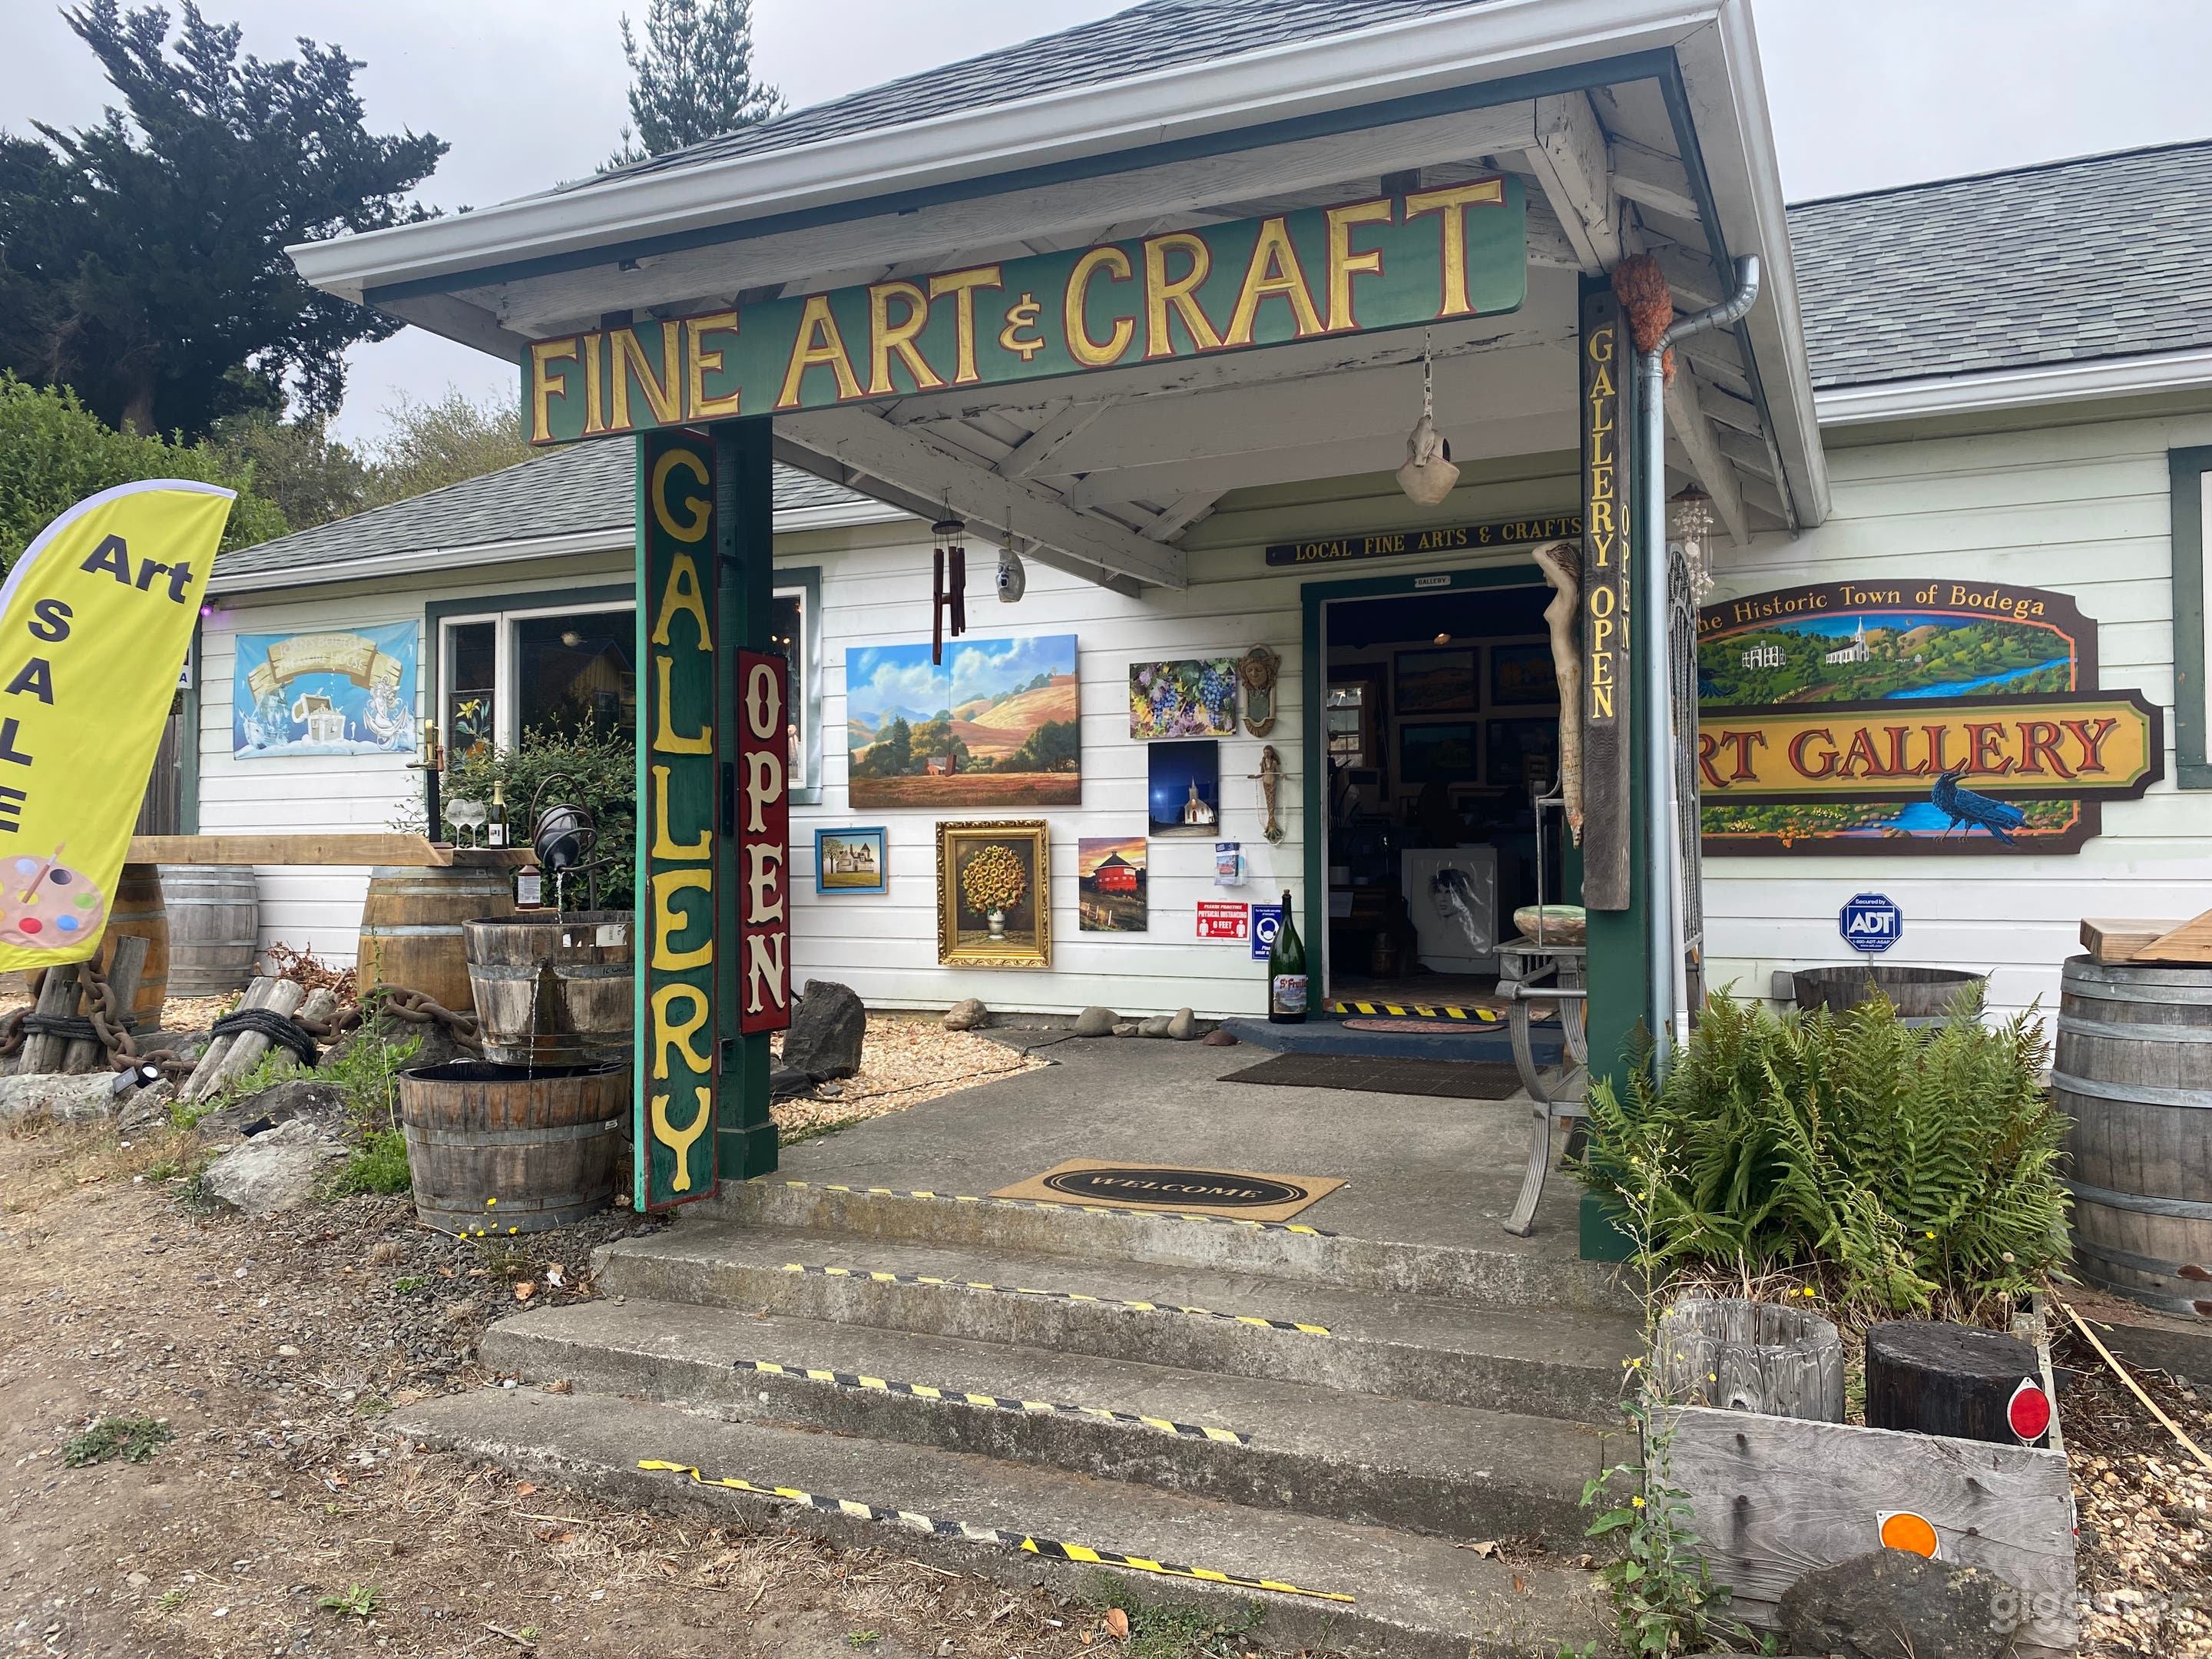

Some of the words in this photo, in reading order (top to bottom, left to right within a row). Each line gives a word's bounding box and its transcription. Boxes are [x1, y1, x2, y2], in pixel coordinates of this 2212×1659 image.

[529, 310, 742, 445] FINE
[773, 263, 1003, 410] ART
[998, 292, 1046, 362] &
[1065, 176, 1507, 369] CRAFT
[1589, 329, 1616, 567] GALLERY
[79, 533, 194, 604] Art
[1295, 540, 1353, 561] LOCAL
[1364, 535, 1405, 555] FINE
[1418, 528, 1468, 550] ARTS
[1479, 525, 1492, 544] &
[1502, 516, 1582, 541] CRAFTS
[1418, 577, 1446, 585] GALLERY
[1621, 504, 1630, 651] OPEN
[1697, 608, 1723, 634] he
[1733, 592, 1828, 624] Historic
[1839, 585, 1902, 606] Town
[1915, 584, 1938, 604] of
[1949, 584, 2045, 620] Bodega
[329, 652, 365, 671] HOUSE
[1590, 586, 1615, 719] OPEN
[0, 598, 74, 833] SALE
[1698, 730, 1765, 788] RT
[1788, 717, 2118, 779] GALLERY
[651, 448, 713, 1192] GALLERY
[744, 663, 786, 1015] OPEN
[1213, 920, 1218, 929] 6
[1218, 921, 1233, 929] FEET
[1849, 912, 1893, 934] ADT
[1089, 1175, 1264, 1200] WELCOME
